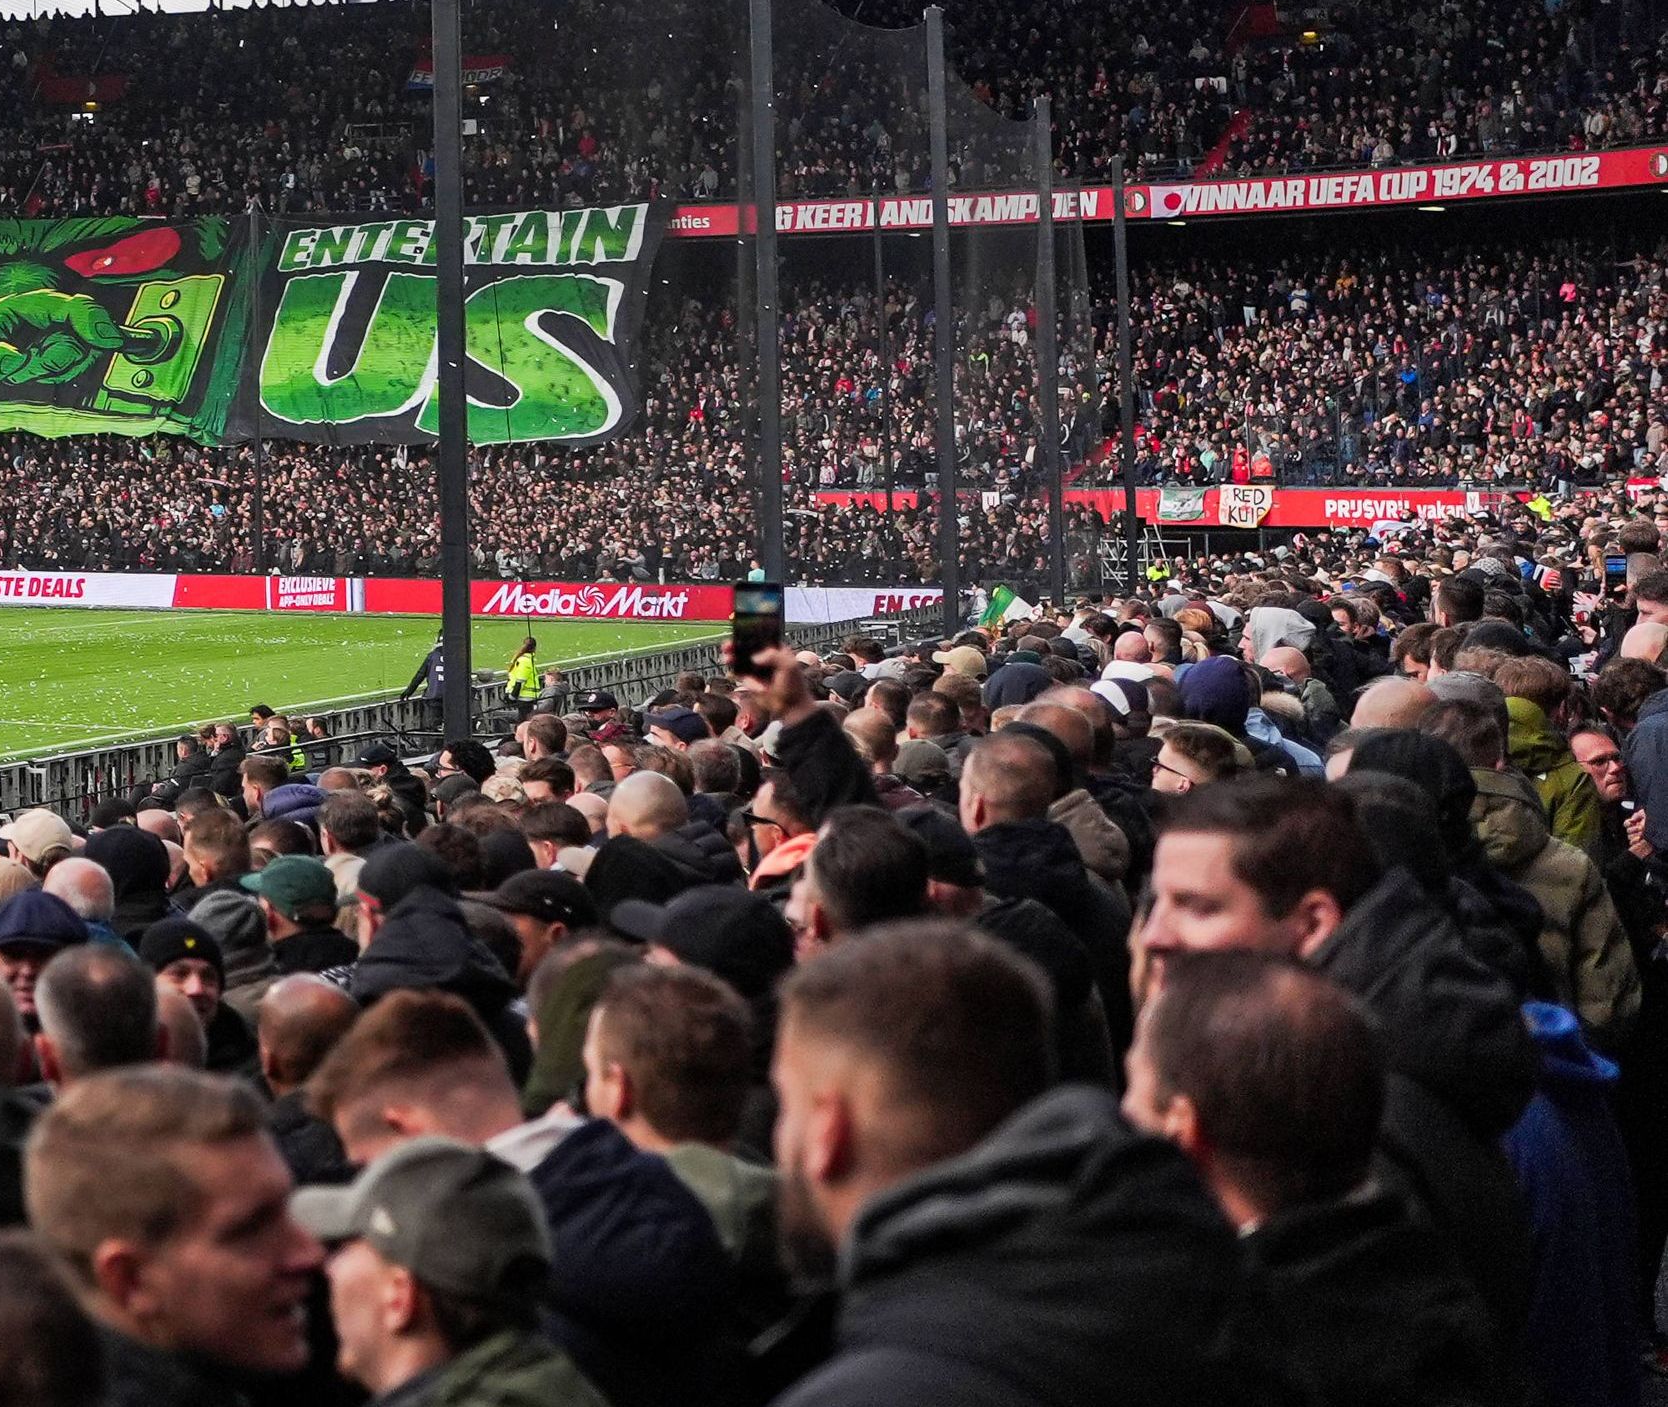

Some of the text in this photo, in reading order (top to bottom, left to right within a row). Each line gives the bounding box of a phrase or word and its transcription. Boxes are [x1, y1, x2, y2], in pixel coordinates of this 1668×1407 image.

[1307, 174, 1375, 206] UEFA
[1379, 170, 1428, 201] CUP
[1431, 165, 1495, 198] 1974
[1527, 155, 1601, 190] 2002
[795, 202, 864, 230] KEER
[258, 269, 625, 447] US
[1233, 487, 1265, 506] RED
[1228, 505, 1267, 524] KUIP
[1416, 500, 1466, 519] vakan
[27, 577, 86, 598] DEALS
[278, 577, 336, 595] EXCLUSIEVE
[482, 583, 688, 618] Media Markt
